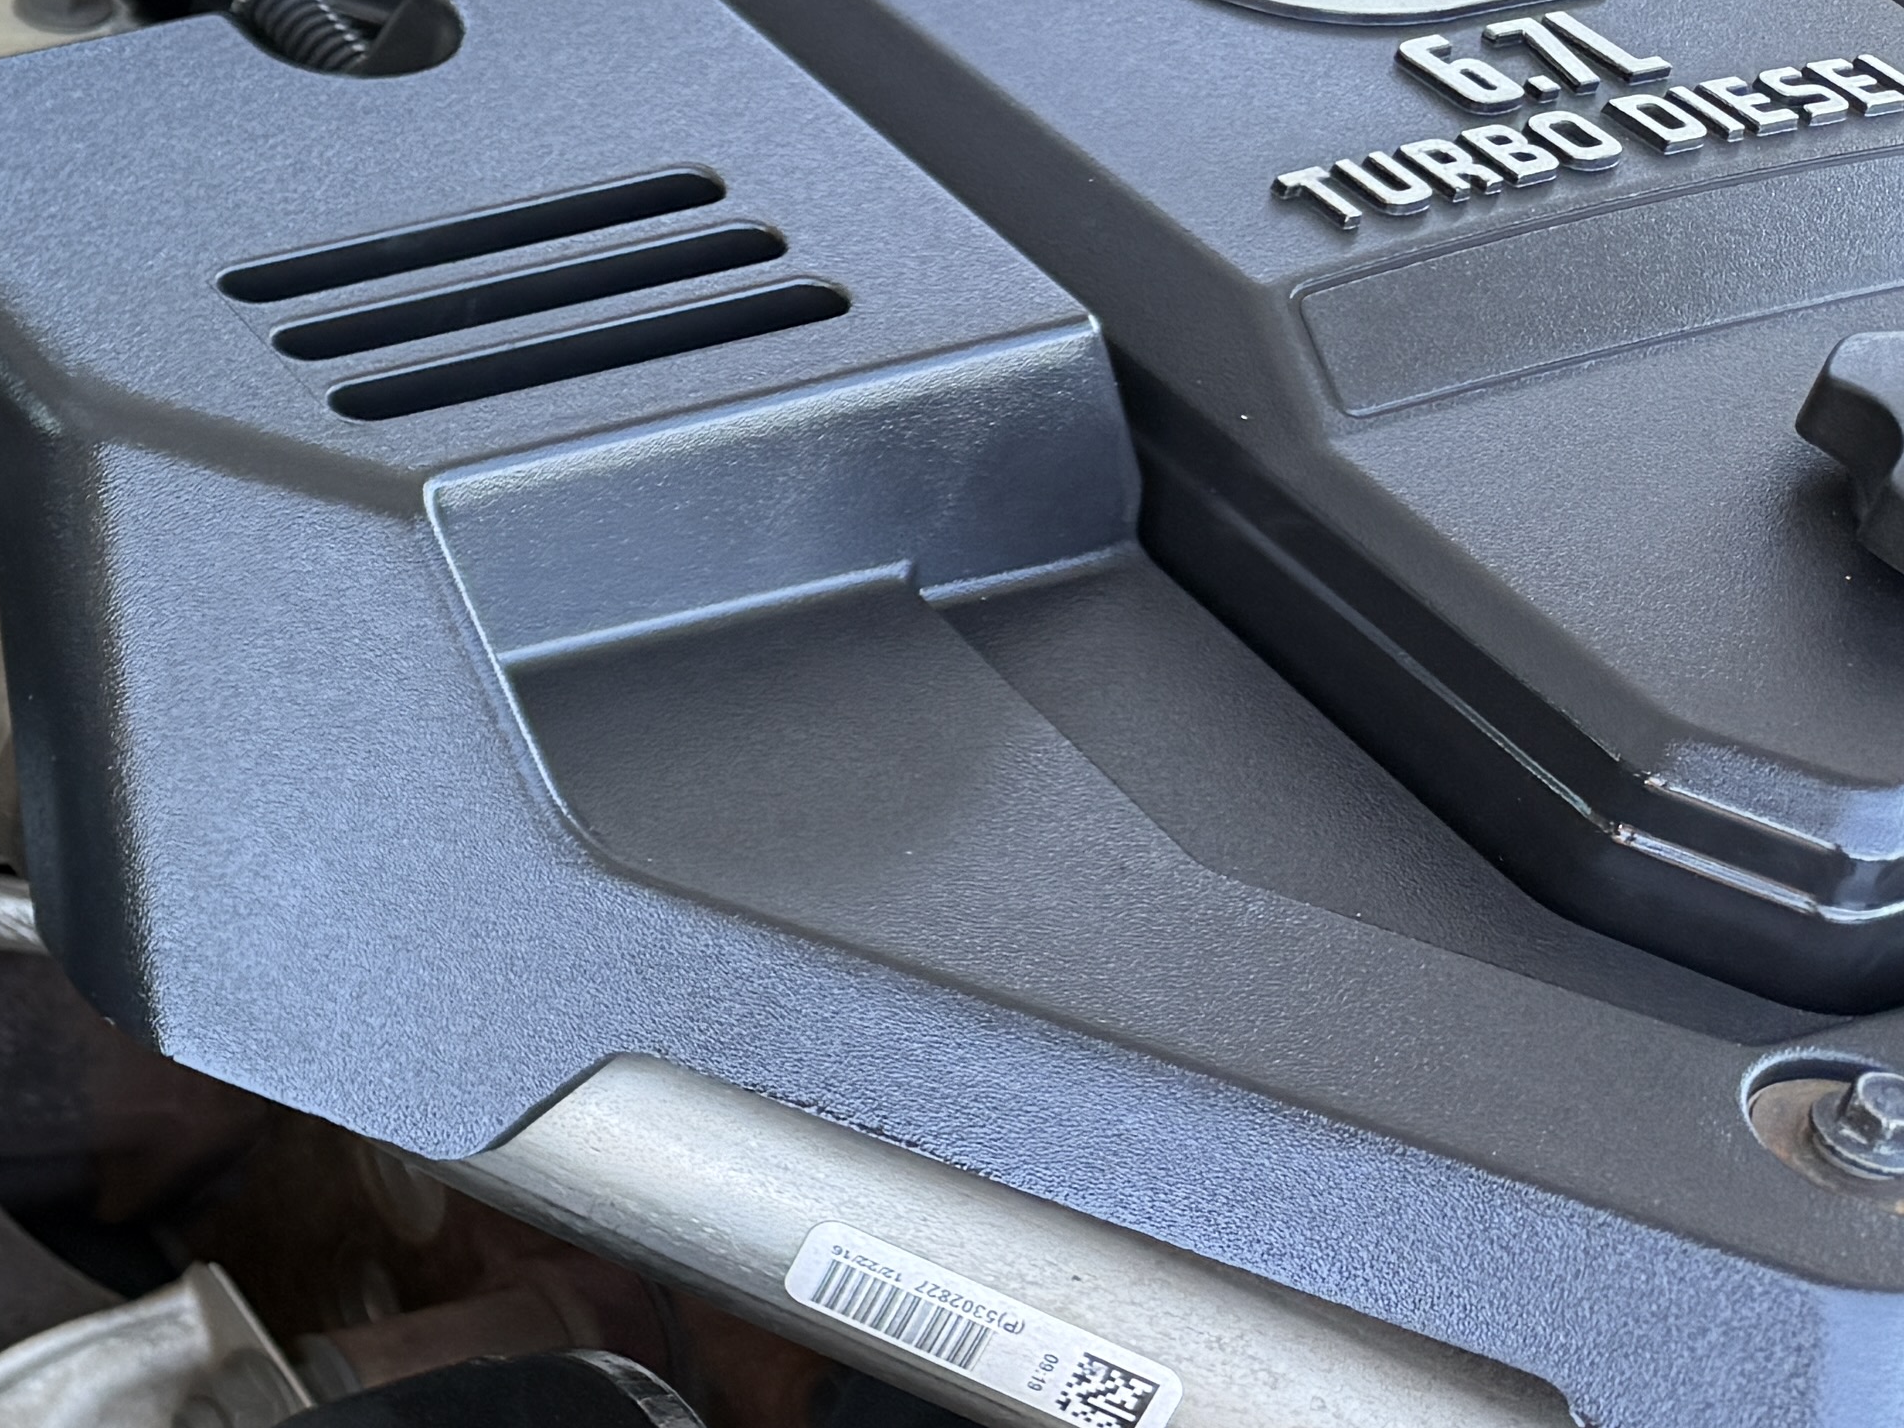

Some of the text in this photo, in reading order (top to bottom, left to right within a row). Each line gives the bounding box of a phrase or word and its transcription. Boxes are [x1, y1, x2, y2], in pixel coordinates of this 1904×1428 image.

[1394, 10, 1672, 114] 6.7L
[1271, 53, 1904, 230] TURBO DIESEL
[831, 1244, 1025, 1335] (P)5302827 12/22/16
[1026, 1352, 1059, 1392] 09:19
